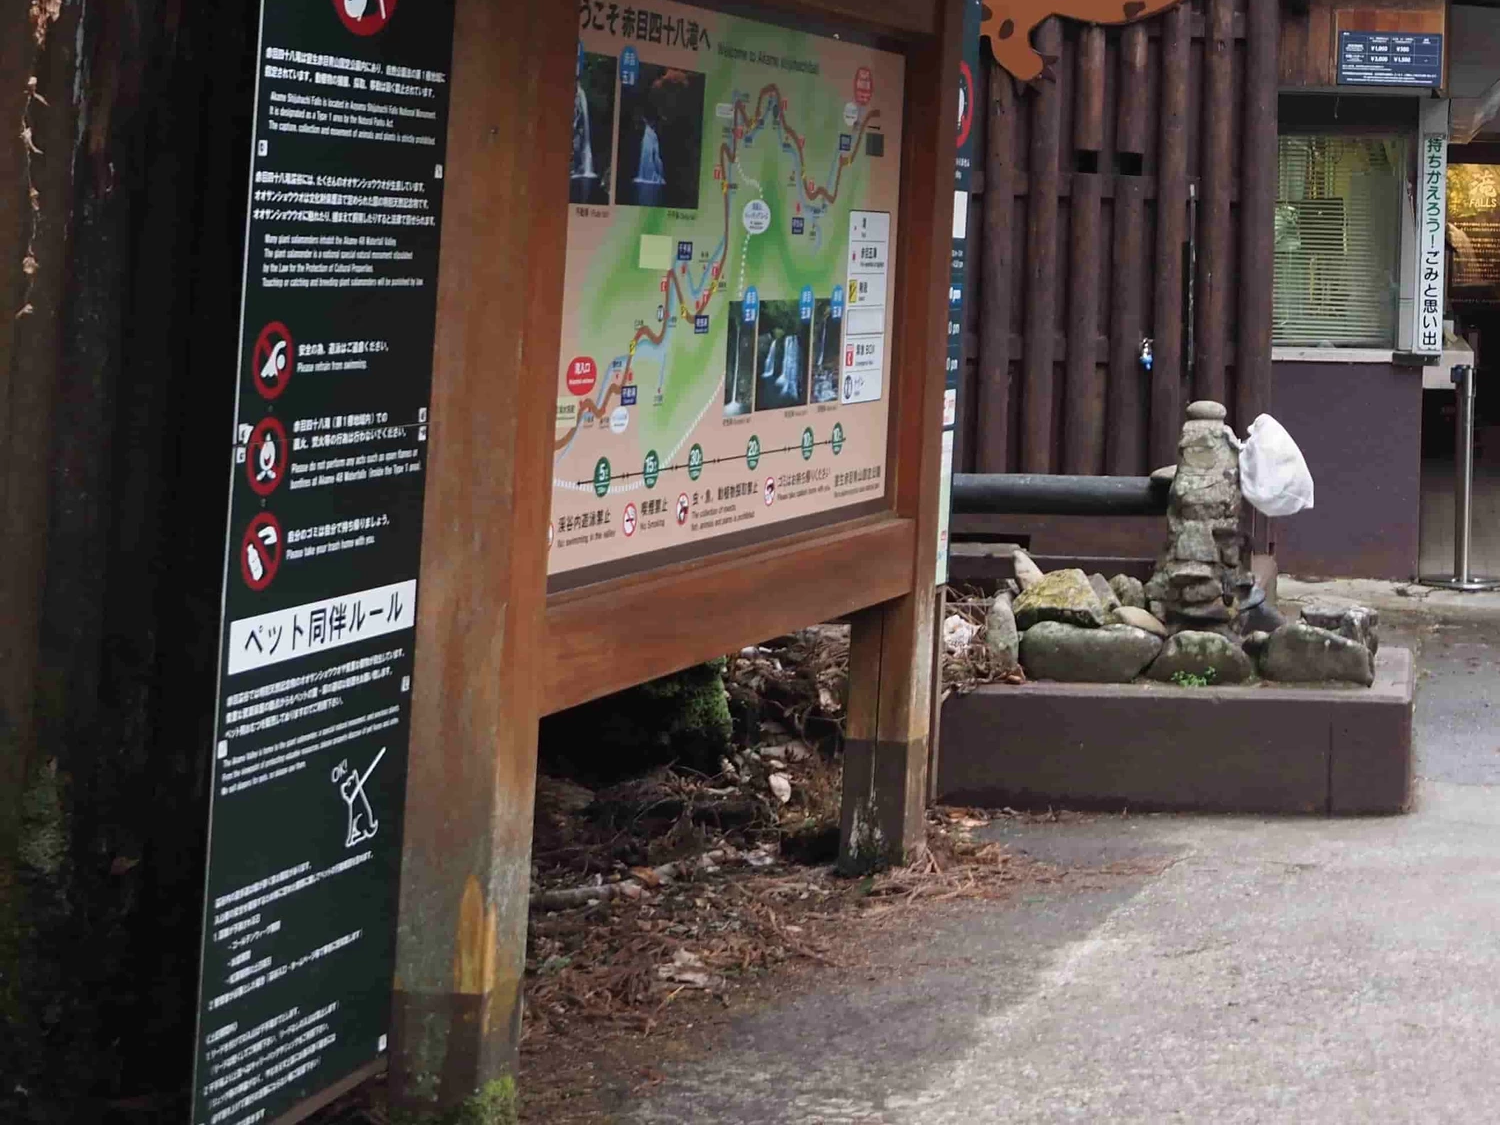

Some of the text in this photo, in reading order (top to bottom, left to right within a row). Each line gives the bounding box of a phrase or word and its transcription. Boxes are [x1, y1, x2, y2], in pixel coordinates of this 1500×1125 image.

[1422, 137, 1443, 350] 持ちかえろう！ごみと思い出
[245, 591, 403, 655] ペット同伴ルール
